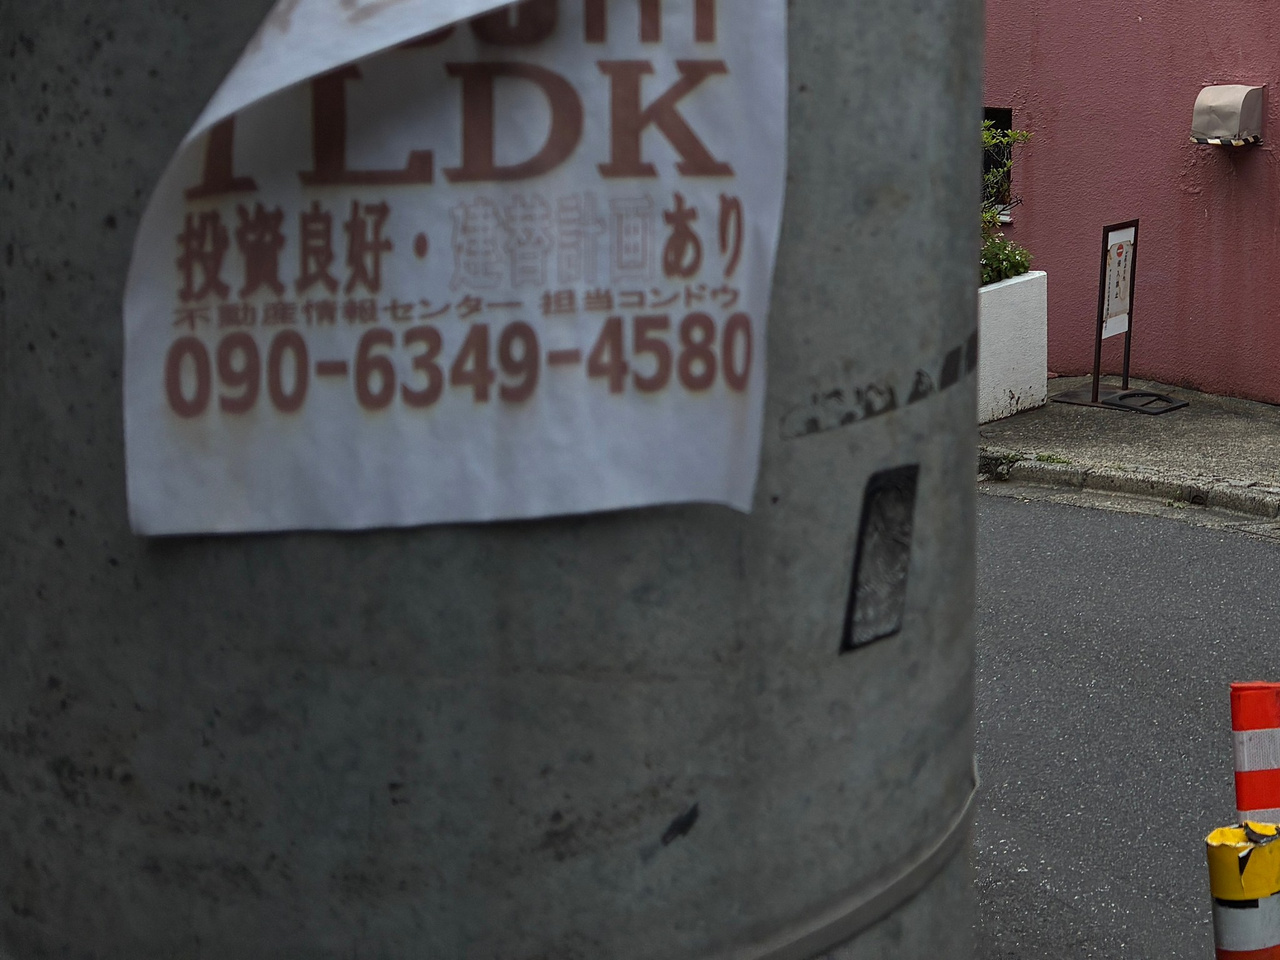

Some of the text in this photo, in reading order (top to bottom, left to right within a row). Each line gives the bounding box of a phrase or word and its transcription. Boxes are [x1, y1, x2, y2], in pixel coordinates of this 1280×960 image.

[173, 284, 740, 331] 不動産情報センター 担当コンドウ
[163, 311, 753, 420] 090-6349-4580
